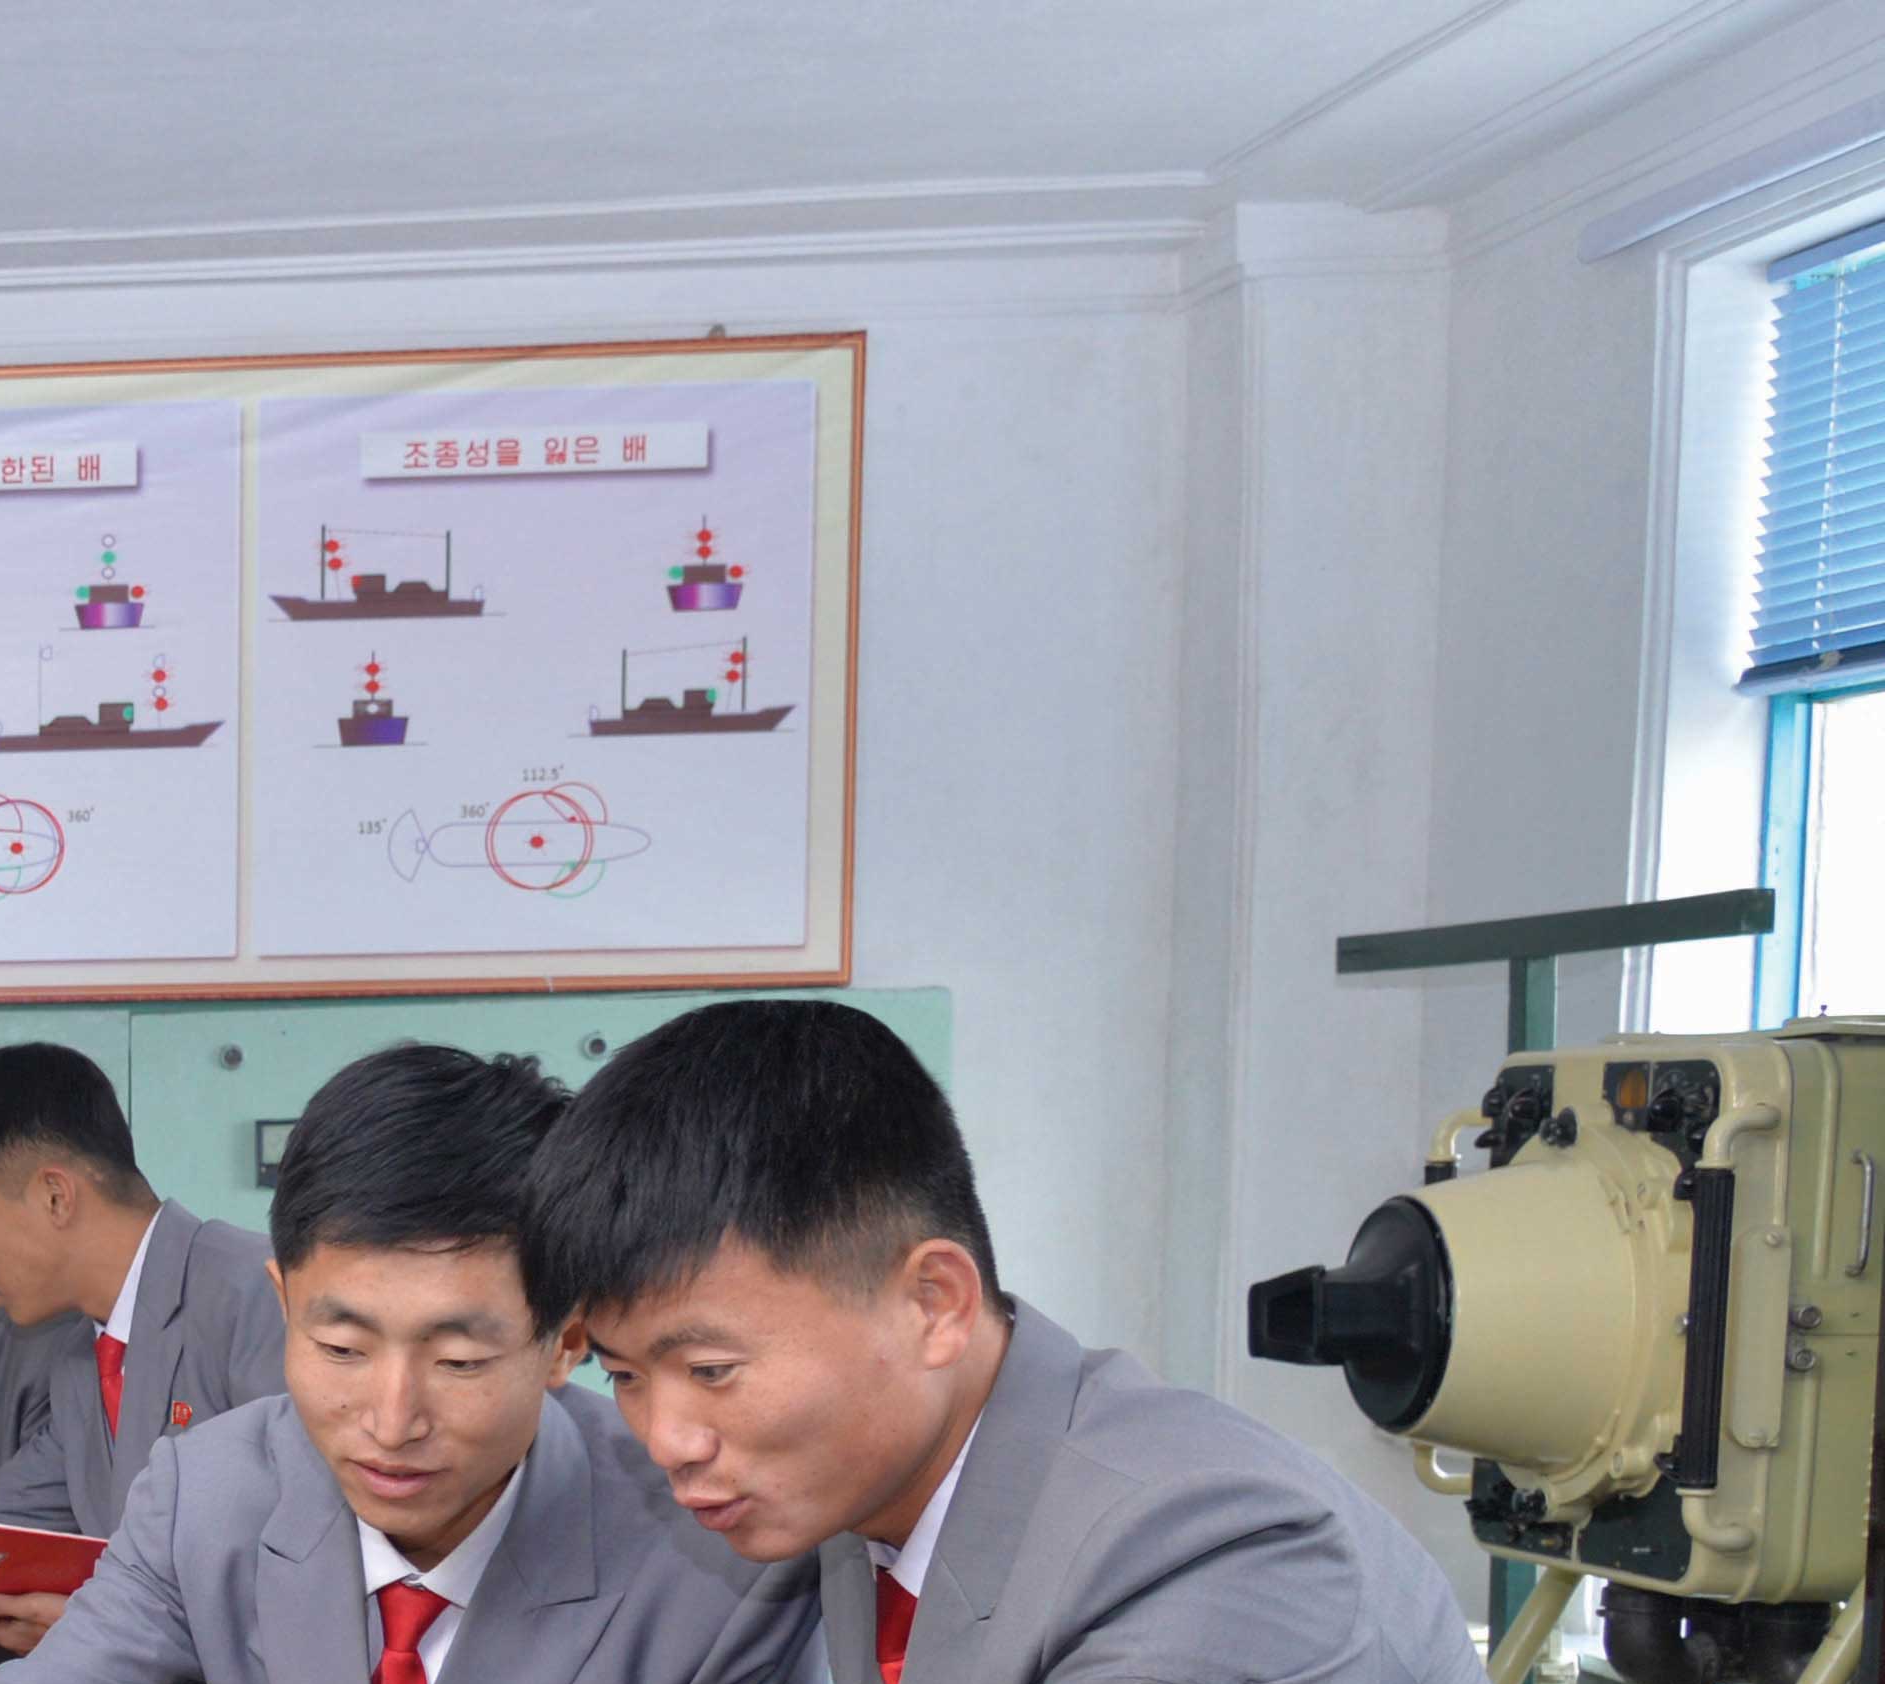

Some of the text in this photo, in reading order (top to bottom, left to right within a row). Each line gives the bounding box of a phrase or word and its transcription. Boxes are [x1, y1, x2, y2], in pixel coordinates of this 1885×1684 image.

[77, 453, 103, 482] 배
[403, 437, 521, 470] 조종성을
[622, 433, 648, 463] 배
